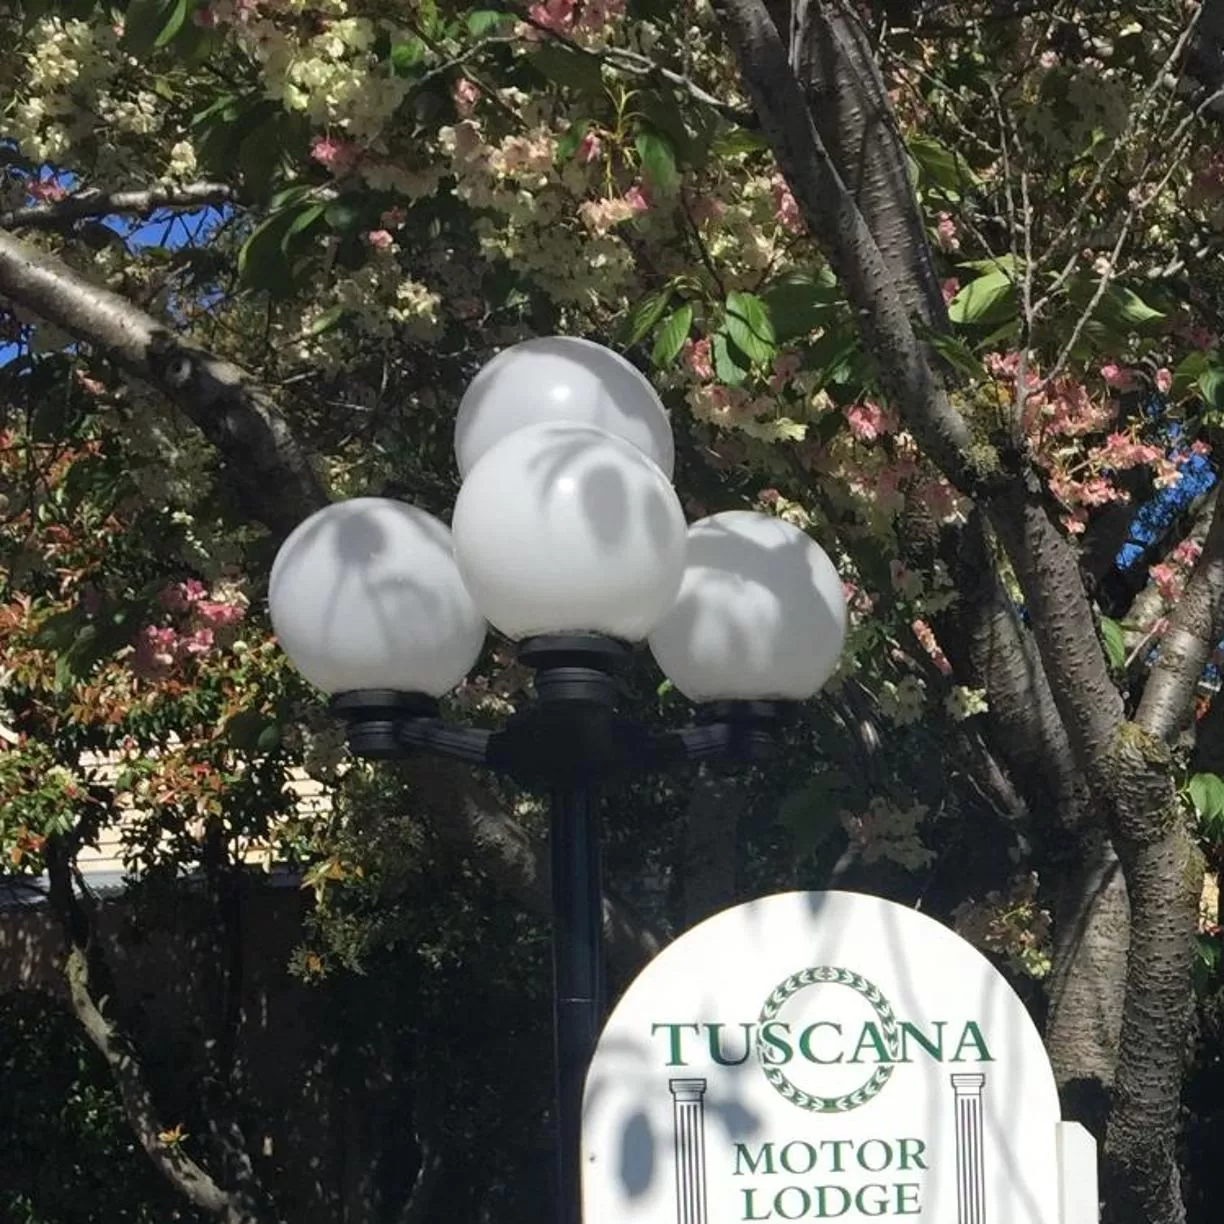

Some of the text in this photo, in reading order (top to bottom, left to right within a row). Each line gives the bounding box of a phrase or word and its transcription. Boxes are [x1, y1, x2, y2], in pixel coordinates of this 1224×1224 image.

[651, 1020, 997, 1067] TUSCANA
[732, 1137, 929, 1176] MOTOR
[741, 1182, 923, 1221] LODGE
